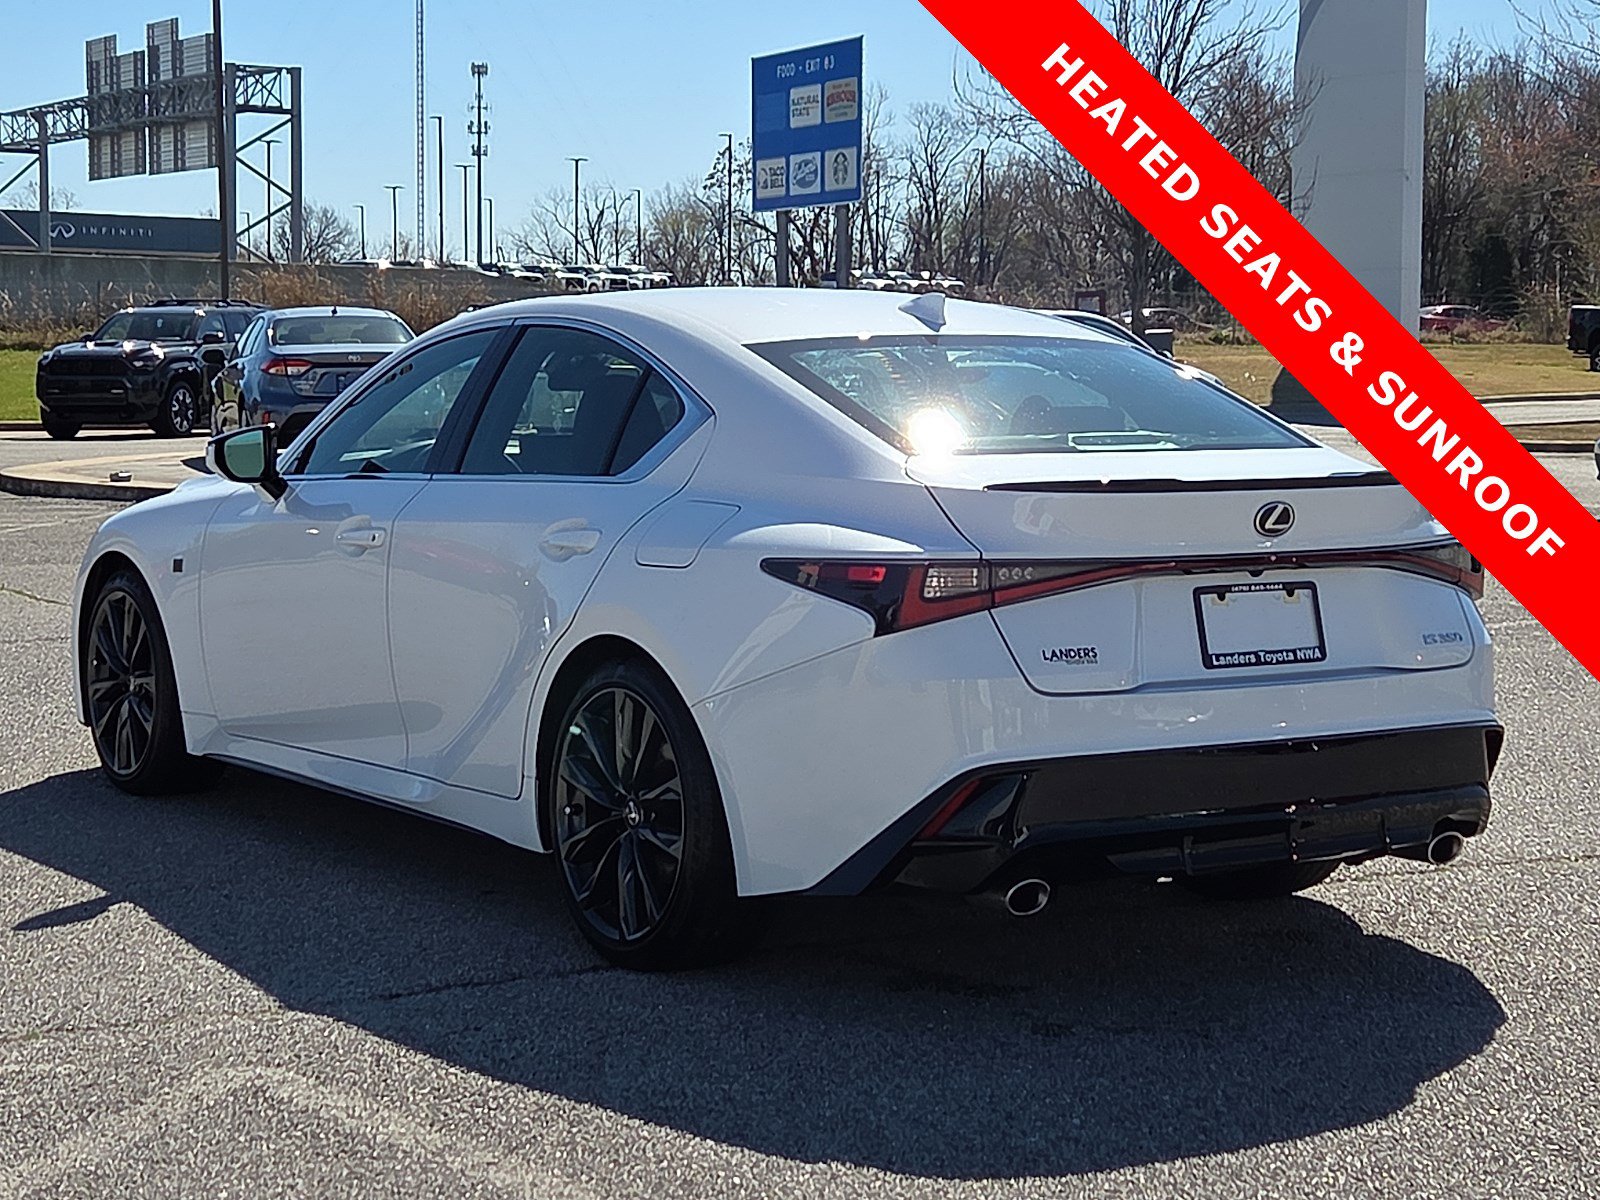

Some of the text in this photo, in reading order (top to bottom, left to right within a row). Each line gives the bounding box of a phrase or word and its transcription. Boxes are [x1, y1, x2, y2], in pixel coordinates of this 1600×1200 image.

[777, 62, 796, 78] FOOD
[805, 57, 821, 74] EXIT
[768, 165, 785, 177] TACO
[769, 177, 784, 190] BELL
[82, 225, 153, 238] INFINITI
[1041, 646, 1098, 662] LANDERS
[1212, 647, 1322, 666] Landers Toyota NWA
